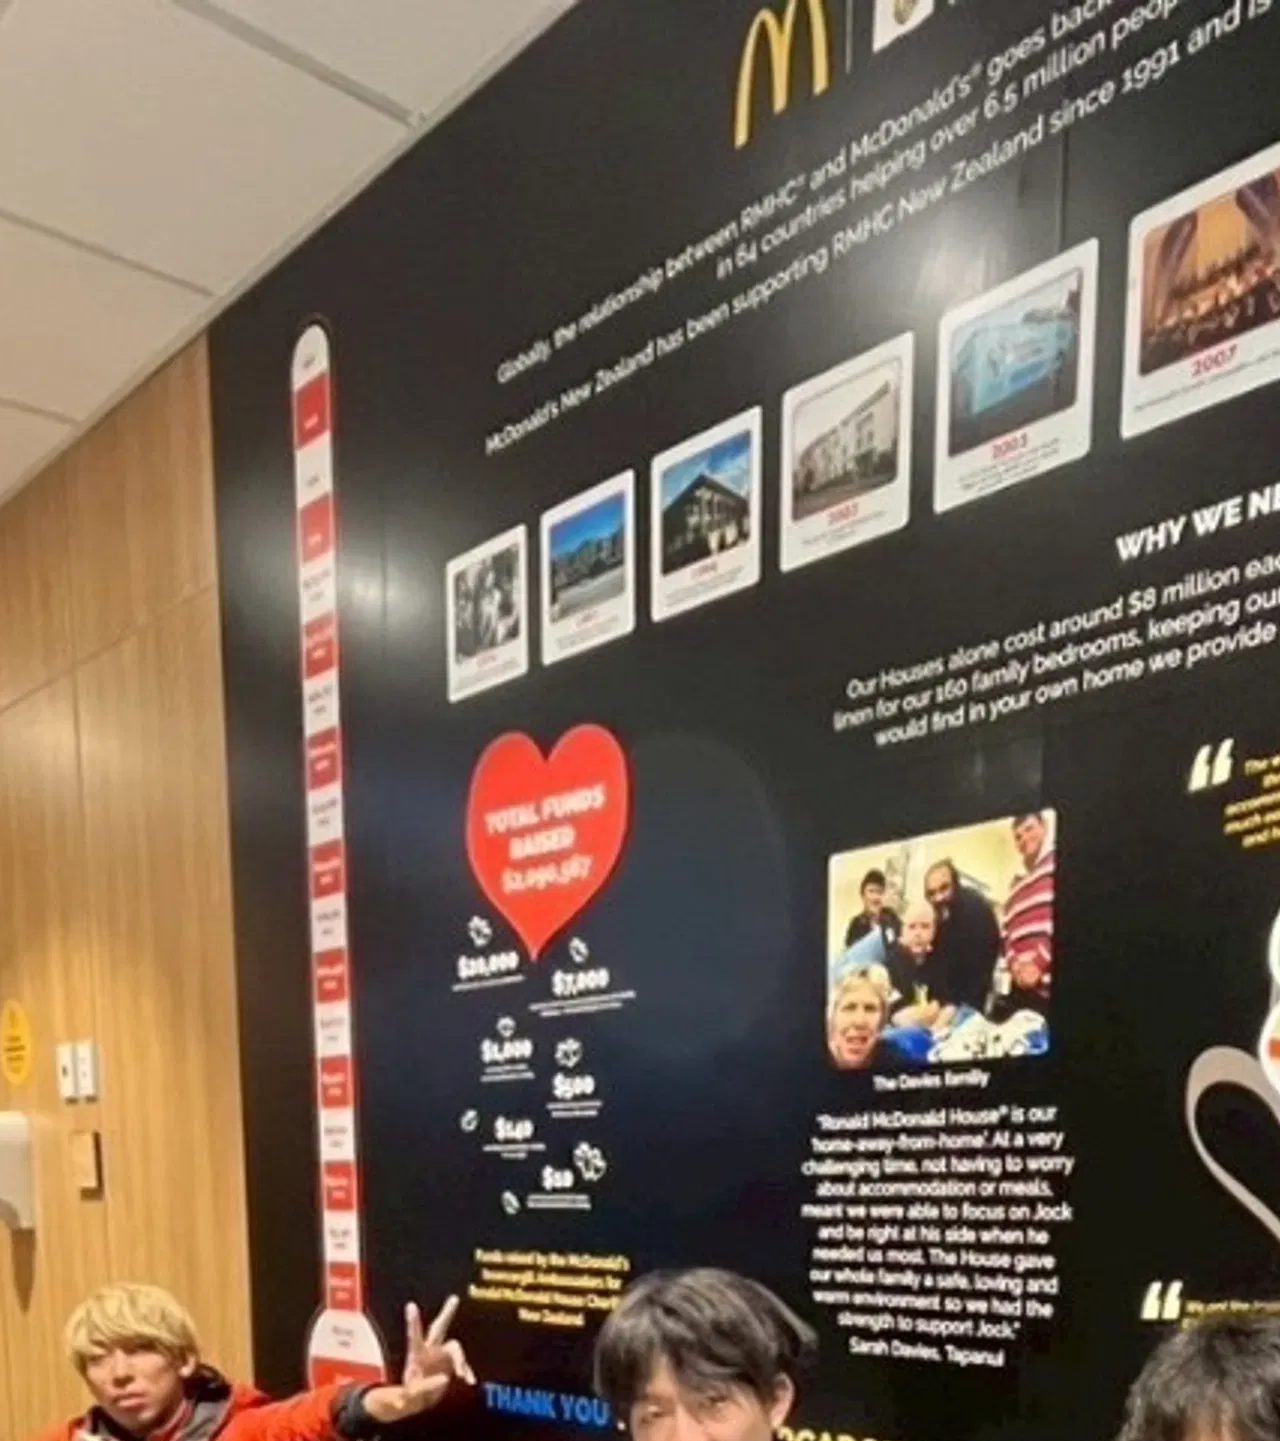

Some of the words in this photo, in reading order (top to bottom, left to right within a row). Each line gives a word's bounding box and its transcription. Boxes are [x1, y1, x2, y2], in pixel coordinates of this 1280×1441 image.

[810, 148, 846, 190] and
[987, 28, 1045, 86] goes
[851, 140, 925, 199] helping
[930, 109, 978, 152] over
[1023, 31, 1105, 97] million
[657, 328, 684, 356] has
[687, 303, 729, 339] been
[733, 246, 829, 313] supporting
[834, 203, 894, 256] RMHC
[899, 179, 945, 220] New
[949, 115, 1043, 193] Zealand
[1050, 81, 1115, 133] since
[1122, 41, 1180, 93] 1991
[1188, 0, 1241, 53] and
[1116, 516, 1186, 560] WHY
[1192, 497, 1242, 536] WE
[847, 678, 877, 699] Our
[880, 658, 944, 689] Houses
[948, 641, 999, 670] alone
[1003, 623, 1045, 652] cost
[1050, 597, 1123, 638] around
[1129, 587, 1156, 616] $8
[1162, 566, 1239, 604] million
[876, 699, 898, 718] for
[902, 690, 932, 711] our
[972, 660, 1030, 691] family
[1149, 600, 1240, 640] keeping
[876, 715, 928, 745] would
[932, 705, 964, 731] find
[969, 703, 985, 722] in
[990, 691, 1032, 721] your
[1035, 678, 1078, 703] own
[1083, 659, 1144, 690] home
[1149, 649, 1182, 672] we
[1186, 621, 1277, 668] provide
[1027, 1132, 1063, 1150] very
[1028, 1107, 1057, 1122] our
[1026, 1156, 1074, 1175] worry
[1033, 1202, 1072, 1220] Jock
[484, 1382, 556, 1419] THANK
[560, 1394, 610, 1426] YOU
